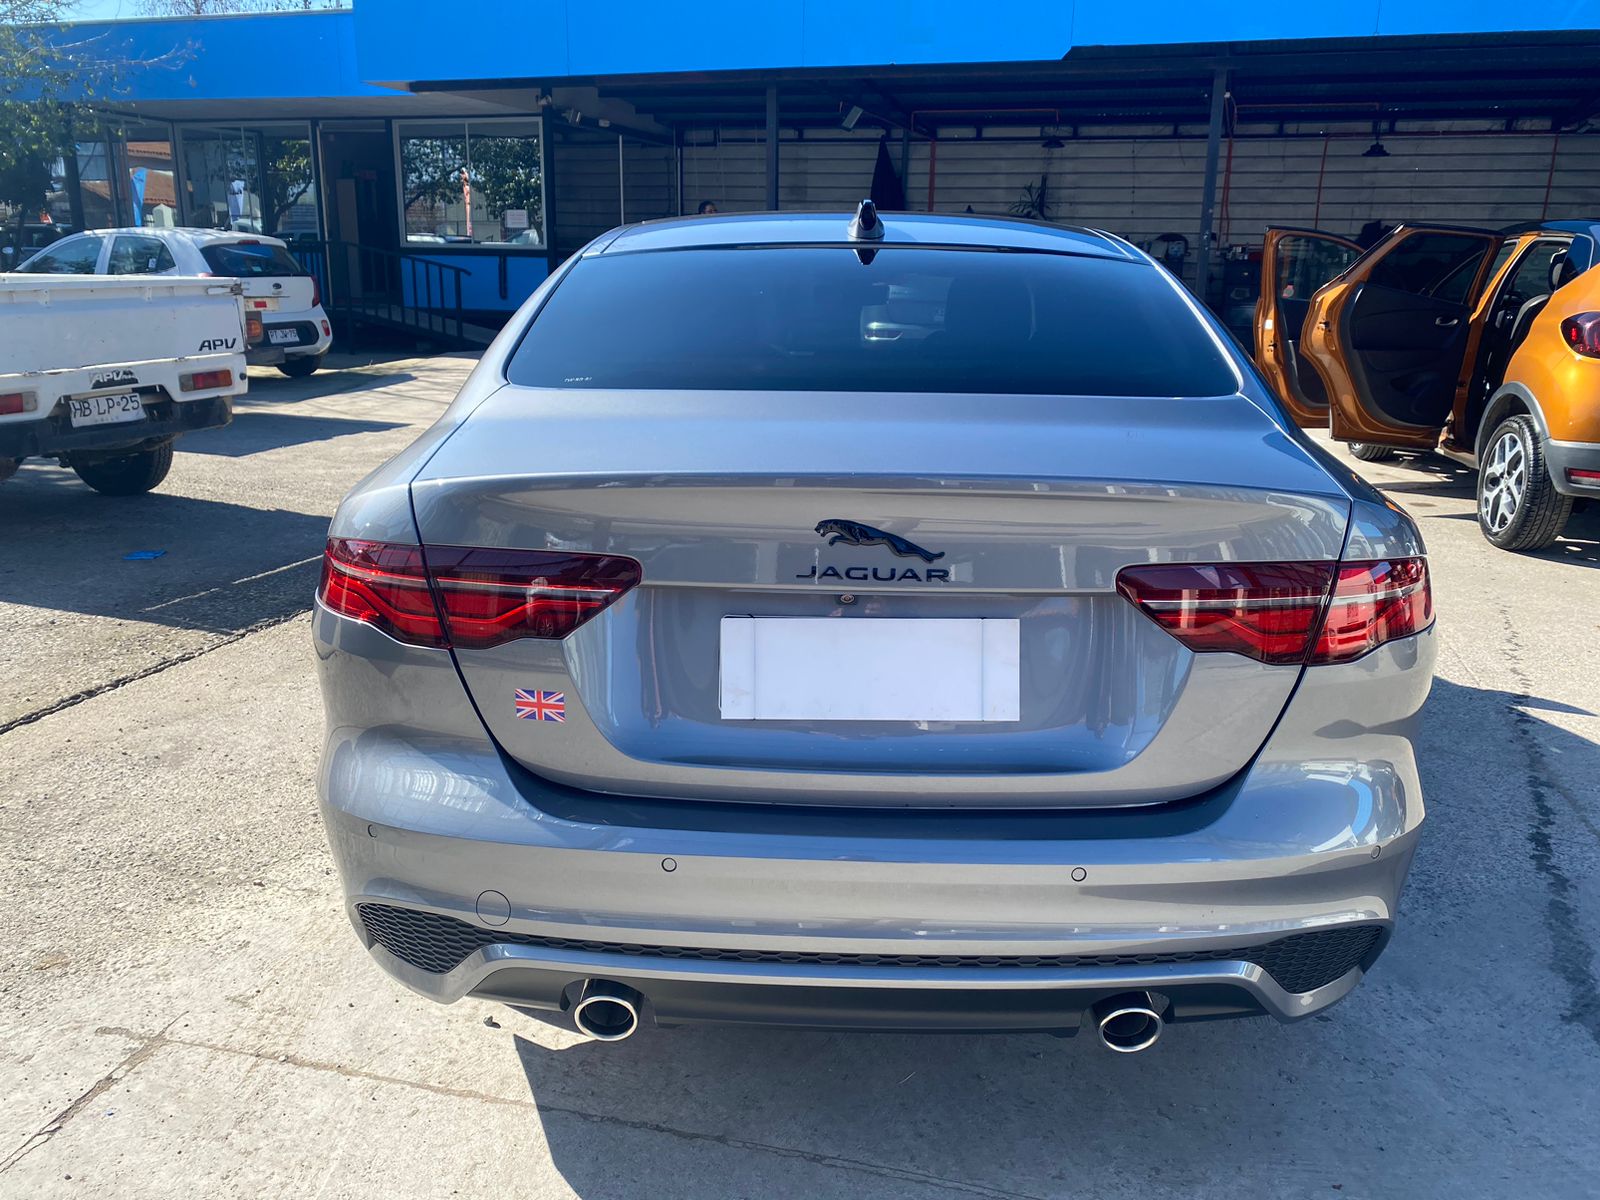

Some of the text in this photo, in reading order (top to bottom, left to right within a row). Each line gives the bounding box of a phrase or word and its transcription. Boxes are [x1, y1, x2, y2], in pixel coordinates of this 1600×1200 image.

[198, 337, 237, 352] APV
[93, 370, 123, 383] APV
[796, 566, 950, 583] JAGUAR
